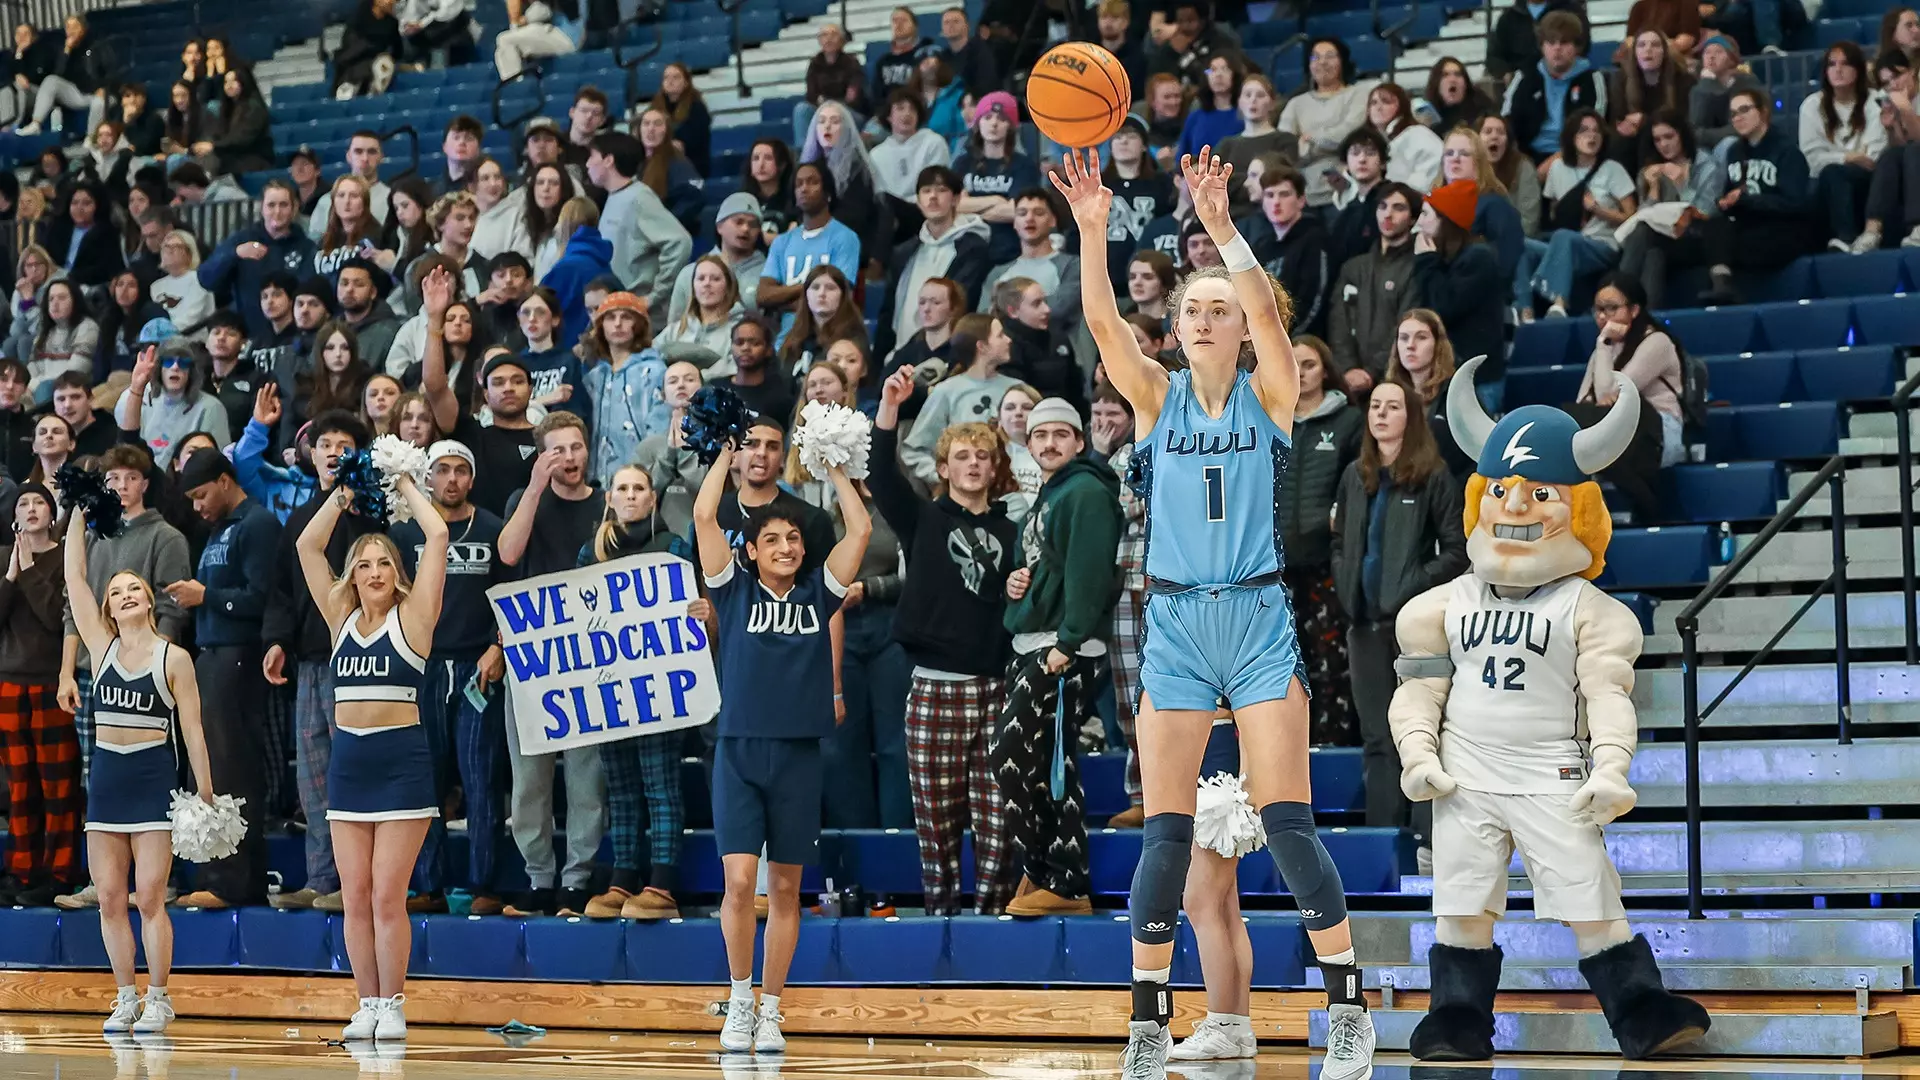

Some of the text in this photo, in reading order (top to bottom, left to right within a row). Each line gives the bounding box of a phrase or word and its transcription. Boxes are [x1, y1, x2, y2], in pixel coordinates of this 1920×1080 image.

[1166, 425, 1257, 457] WWU
[1203, 465, 1226, 522] 1
[494, 562, 688, 634] WE PUT
[746, 601, 820, 635] WWU
[503, 616, 708, 683] WILDCATS
[1461, 610, 1551, 657] WWU
[337, 655, 391, 677] WWU
[1482, 656, 1526, 691] 42
[100, 684, 154, 712] WWU
[541, 669, 697, 740] SLEEP
